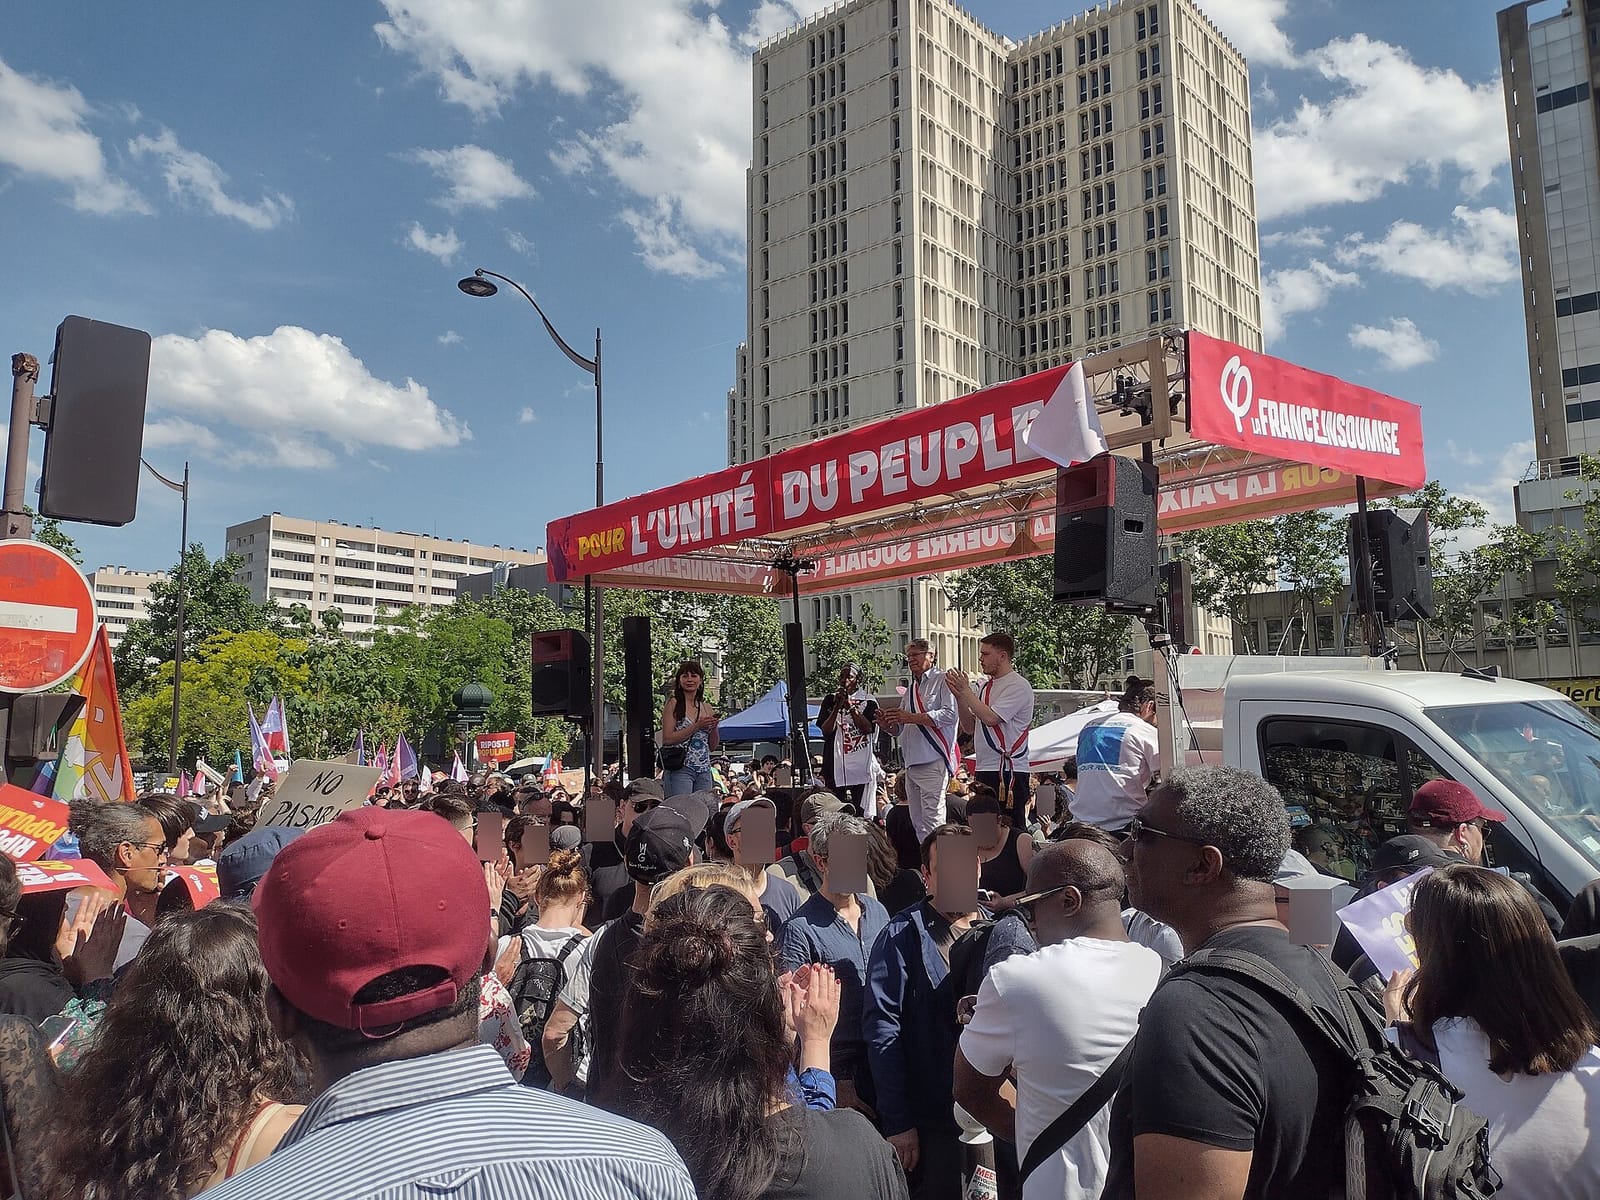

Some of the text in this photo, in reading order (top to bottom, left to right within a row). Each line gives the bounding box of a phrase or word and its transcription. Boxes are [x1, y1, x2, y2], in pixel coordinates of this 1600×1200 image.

[577, 526, 626, 561] POUR
[630, 470, 757, 556] L'UNITÉ
[781, 458, 839, 520] DU
[479, 747, 514, 756] POPULAIRE
[480, 739, 510, 748] RIPOSTE
[306, 770, 344, 795] NO
